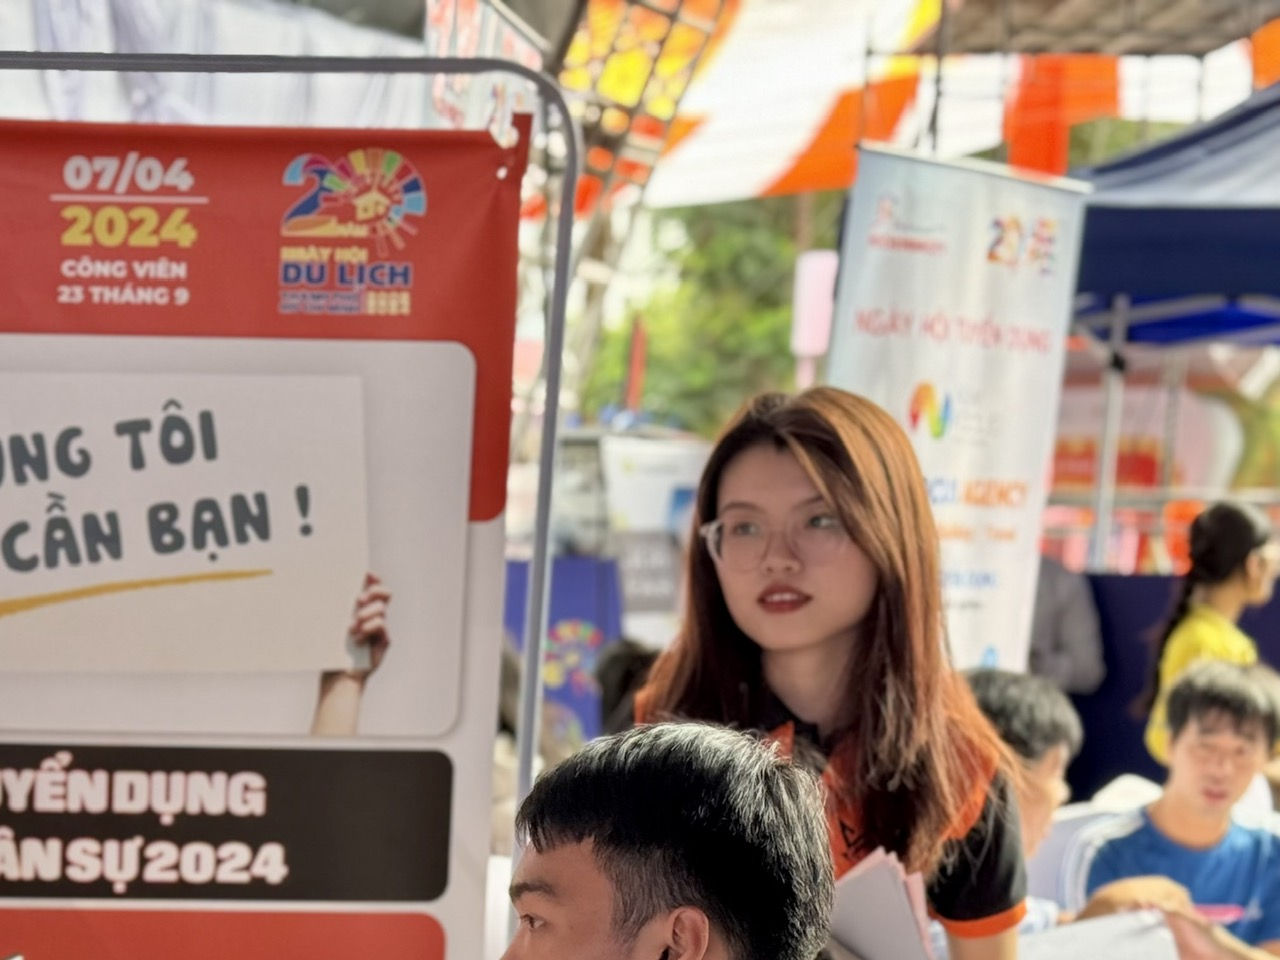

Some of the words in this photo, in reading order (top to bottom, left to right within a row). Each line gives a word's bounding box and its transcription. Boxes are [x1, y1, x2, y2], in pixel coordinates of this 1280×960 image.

[63, 151, 194, 194] 07/04
[60, 205, 198, 247] 2024
[61, 255, 127, 278] CÔNG
[132, 256, 187, 279] VIÊN
[281, 262, 327, 286] DU
[57, 285, 84, 303] 23
[88, 282, 169, 305] THÁNG
[174, 287, 190, 306] 9
[114, 398, 218, 471] TÔI
[0, 492, 122, 573] CẦN
[147, 491, 272, 562] BẠN
[112, 769, 267, 826] DỤNG
[66, 834, 143, 894] SỰ
[144, 840, 289, 885] 2024
